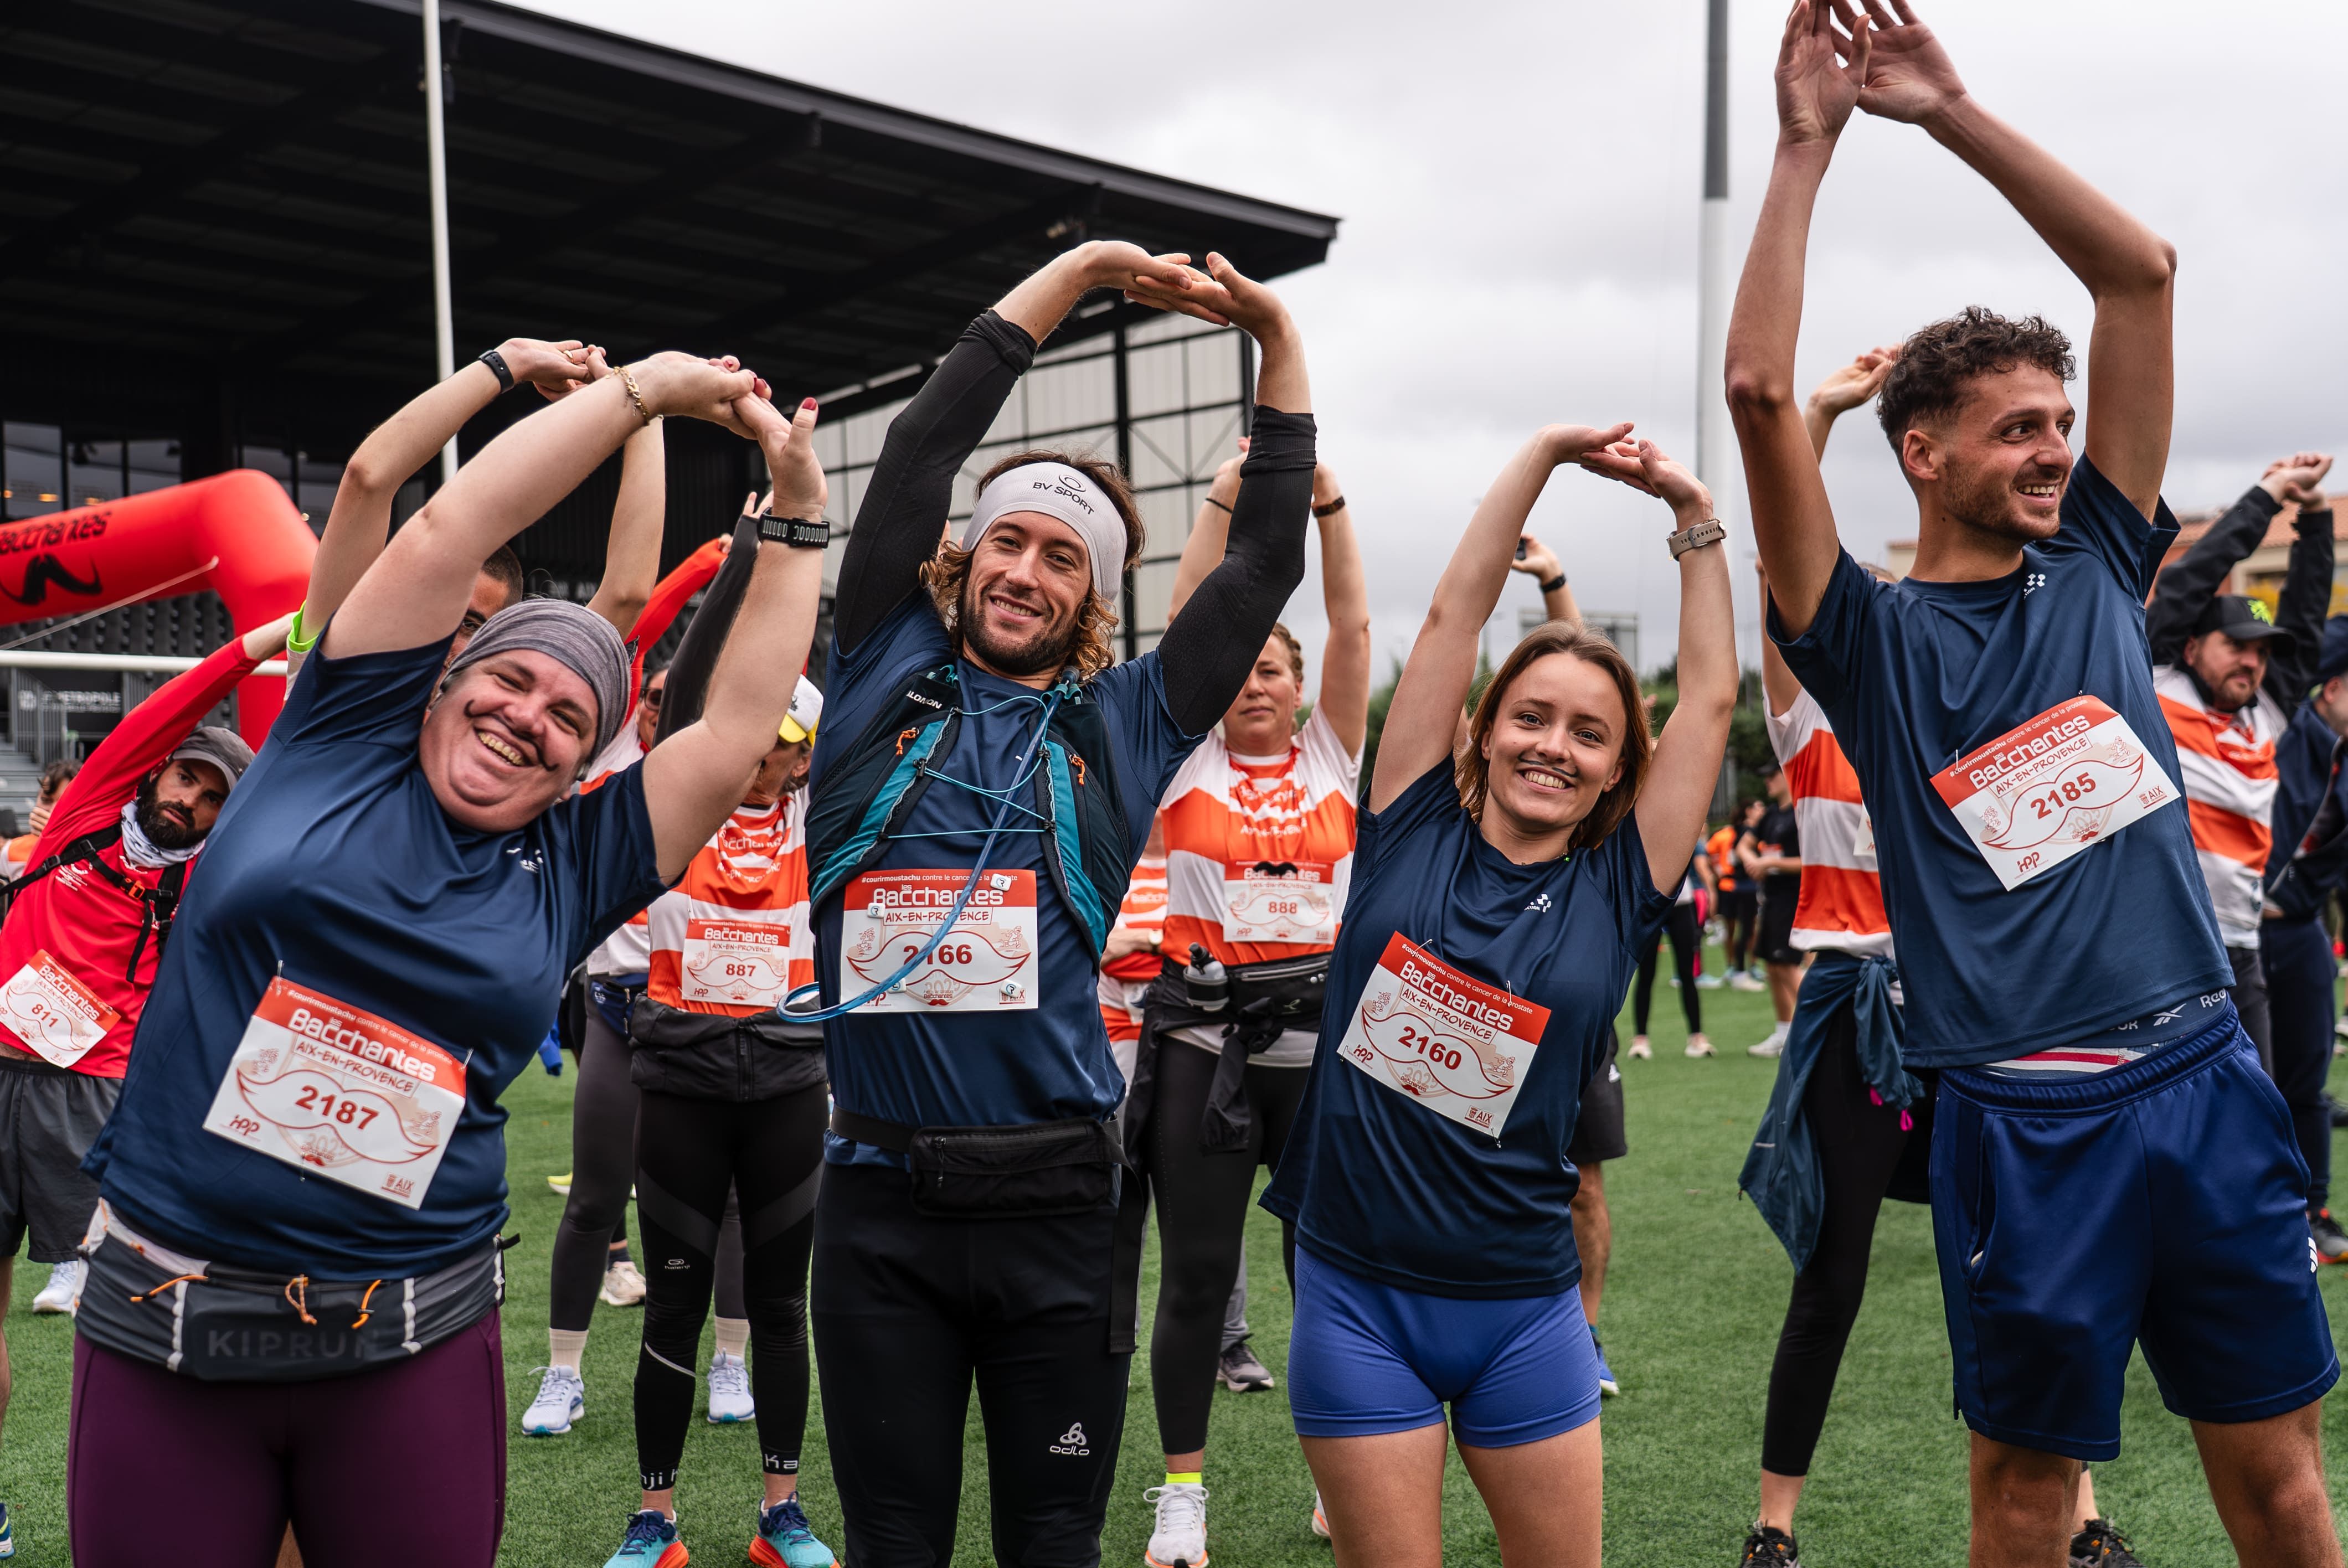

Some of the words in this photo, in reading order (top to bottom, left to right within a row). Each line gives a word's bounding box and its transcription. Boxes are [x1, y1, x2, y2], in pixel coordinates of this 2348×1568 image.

[1032, 482, 1053, 490] BV
[1054, 486, 1094, 515] SPORT
[1949, 740, 2007, 778] #courirmoustachu
[2006, 730, 2025, 744] contre
[2031, 716, 2051, 730] cancer
[2051, 711, 2059, 720] de
[2059, 708, 2066, 716] la
[1969, 715, 2090, 790] Bacchantes
[1993, 752, 2005, 761] les
[1995, 737, 2087, 795] AIX-EN-PROVENCE
[2030, 772, 2096, 820] 2185
[2149, 786, 2164, 800] AIX
[862, 874, 921, 883] #courirmoustachu
[885, 911, 989, 922] AIX-EN-PROENCE
[1269, 901, 1297, 914] 888
[704, 927, 779, 945] Bacchantes
[712, 943, 771, 953] AIX-EN-PROVENCE
[903, 944, 972, 965] 2166
[725, 964, 756, 977] 887
[1401, 943, 1446, 974] #courirmoustachu
[1446, 971, 1465, 985] contre
[1471, 984, 1493, 997] cancer
[1493, 993, 1501, 1001] de
[1427, 970, 1436, 980] les
[39, 964, 100, 1020] Bacchantes
[1399, 961, 1514, 1031] Bacchantes
[32, 1004, 58, 1028] 811
[287, 989, 357, 1020] #courirmoustachu
[356, 1017, 381, 1030] contre
[389, 1030, 409, 1044] cancer
[410, 1040, 419, 1049] de
[420, 1043, 427, 1052] la
[329, 1017, 342, 1028] les
[1402, 988, 1492, 1039] AIX-EN-PROVENCE
[288, 1008, 437, 1082] Bacchantes
[1398, 1026, 1462, 1070] 2160
[297, 1041, 414, 1092] AIX-EN-PROVENCE
[295, 1085, 380, 1130] 2187
[1477, 1111, 1493, 1124] AIX
[395, 1178, 415, 1191] AIX
[208, 1329, 378, 1359] KIPRUN
[1049, 1445, 1090, 1456] odlo
